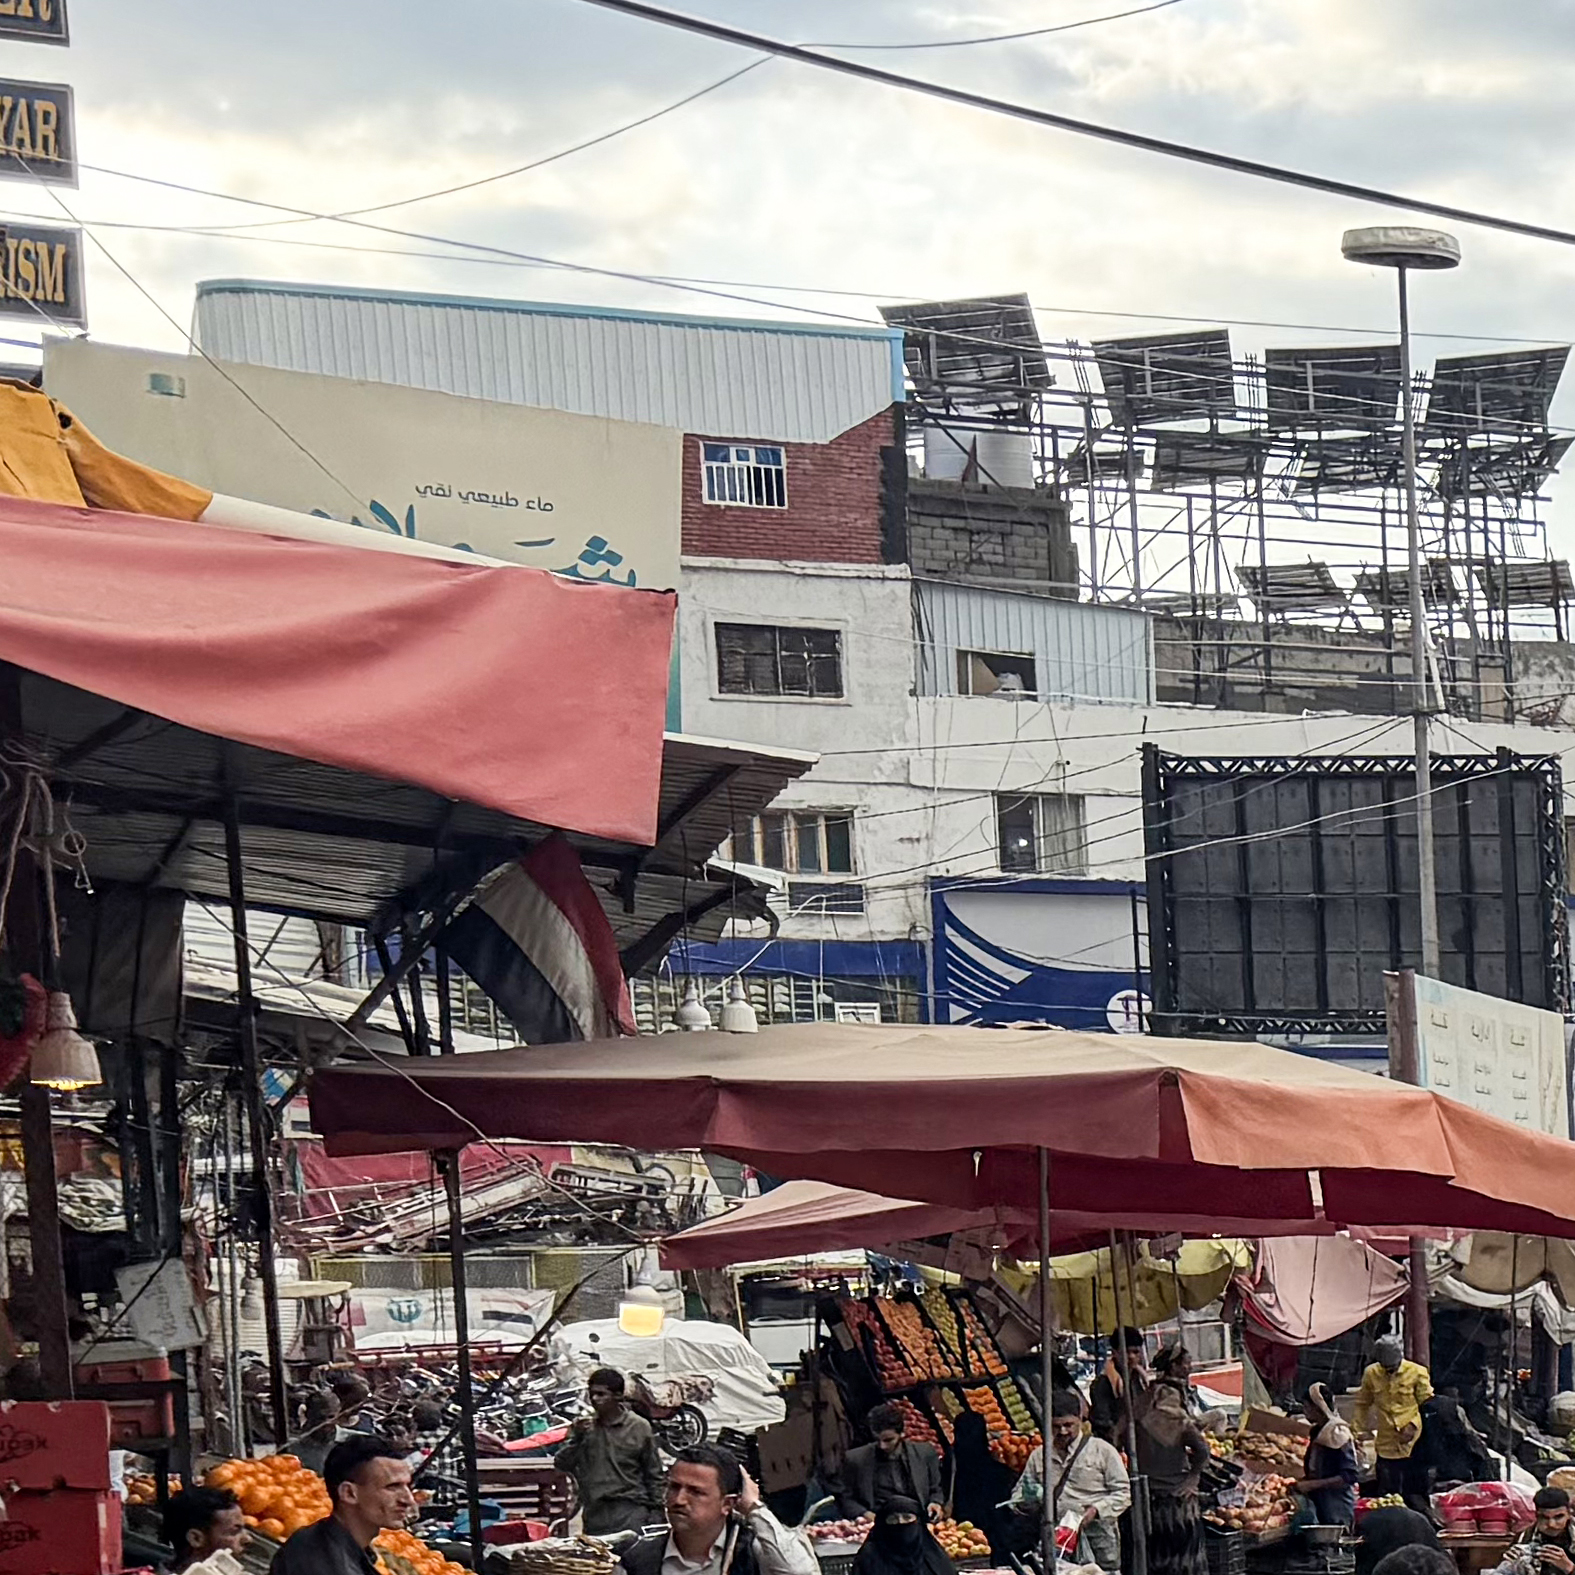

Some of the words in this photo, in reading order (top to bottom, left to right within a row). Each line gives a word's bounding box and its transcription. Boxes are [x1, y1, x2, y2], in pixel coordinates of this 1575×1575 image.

[0, 236, 66, 304] ISM
[415, 481, 453, 500] نقي
[458, 489, 519, 510] طبيعي
[526, 499, 555, 513] ماء
